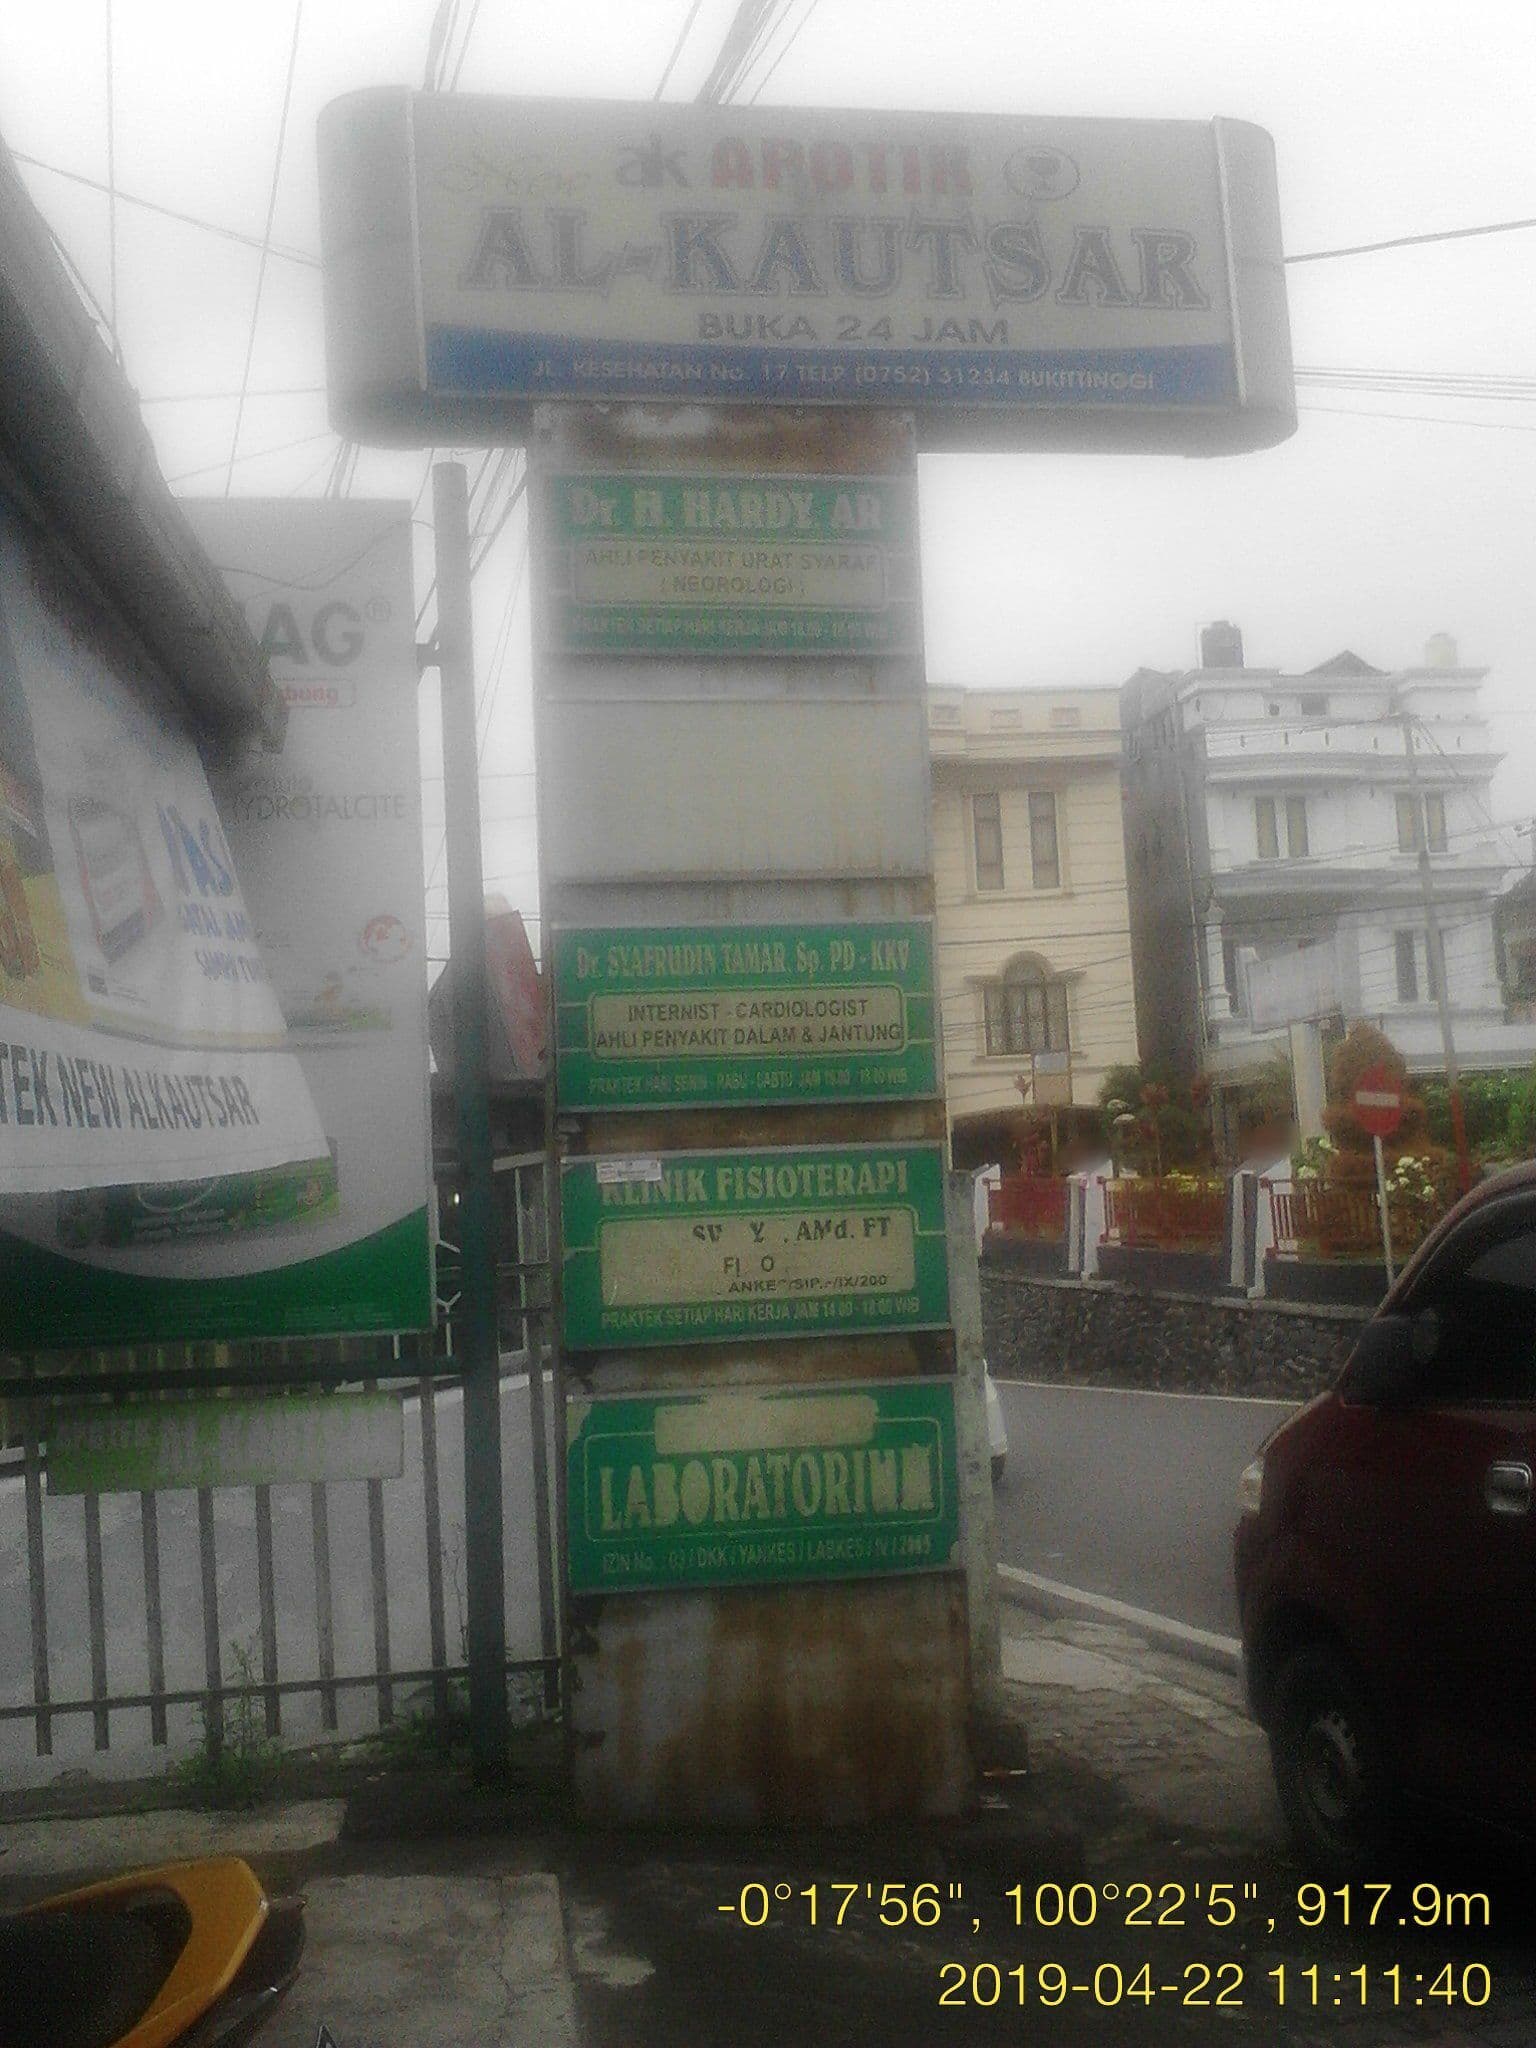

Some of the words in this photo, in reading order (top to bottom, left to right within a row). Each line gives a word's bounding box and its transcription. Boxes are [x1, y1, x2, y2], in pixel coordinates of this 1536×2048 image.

[701, 313, 817, 341] BUKA
[838, 315, 893, 341] 24
[913, 317, 1010, 346] JAM
[573, 360, 703, 380] KESEHATAN
[855, 365, 930, 386] (0752)
[940, 367, 1010, 385] 31234
[1019, 369, 1154, 390] BUKITTINGGI
[585, 549, 635, 567] AHLI
[640, 549, 736, 570] PENYAKIT
[742, 551, 793, 570] URAT
[801, 553, 875, 572] SYARAF
[628, 1003, 720, 1022] INTERNIST
[735, 999, 868, 1019] CARDIOLOGIST
[597, 1029, 638, 1048] AHLI
[642, 1027, 730, 1047] PENYAKIT
[735, 1025, 796, 1044] DALAM
[801, 1024, 813, 1042] &
[819, 1022, 903, 1042] JANTUNG
[57, 1053, 122, 1128] NEW
[122, 1067, 260, 1129] ALKAUTSAR
[717, 1159, 908, 1202] FISIOTERAPI
[602, 1310, 663, 1329] PRAKTEK
[666, 1308, 710, 1326] SETIAP
[715, 1305, 746, 1323] HARI
[749, 1301, 789, 1321] KERJA
